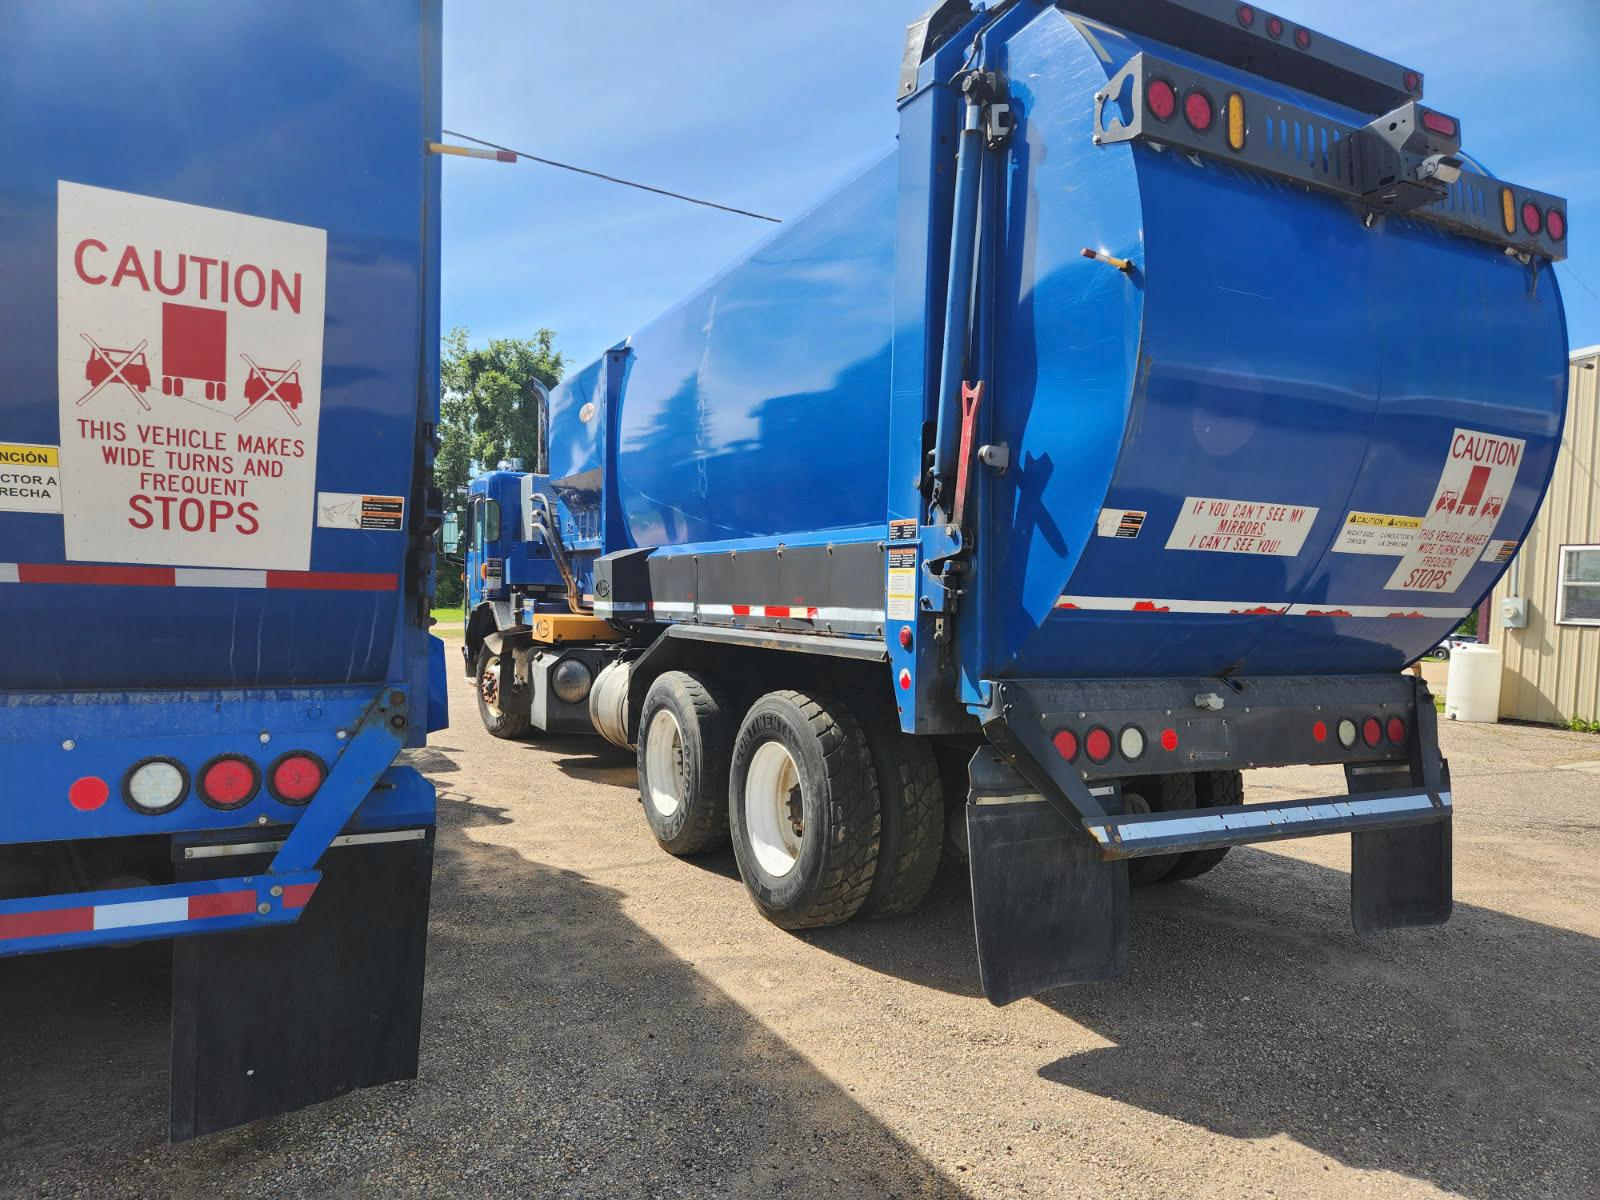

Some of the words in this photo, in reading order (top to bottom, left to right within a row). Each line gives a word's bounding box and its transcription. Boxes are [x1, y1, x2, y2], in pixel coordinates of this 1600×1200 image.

[74, 239, 302, 314] CAUTION
[77, 419, 126, 441] THIS
[137, 425, 226, 451] VEHICLE
[238, 434, 305, 458] MAKES
[1452, 434, 1520, 466] CAUTION
[102, 446, 153, 468] WIDE
[167, 452, 234, 475] TURNS
[243, 458, 283, 478] AND
[0, 474, 43, 485] CTOR
[47, 476, 57, 486] A
[140, 473, 248, 497] FREQUENT
[0, 487, 51, 498] RECHA
[128, 494, 260, 535] STOPS
[1192, 501, 1206, 515] IF
[1208, 502, 1229, 517] YOU
[1233, 503, 1264, 520] CAN'T
[1266, 507, 1287, 522] SEE
[1289, 509, 1306, 523] MY
[1356, 517, 1384, 525] CAUTION
[1189, 535, 1197, 548] I
[1198, 535, 1231, 549] CAN'T
[1233, 537, 1255, 551] SEE
[1257, 539, 1282, 553] YOU!
[1419, 528, 1435, 539] THIS
[1436, 530, 1465, 543] VEHICLE
[1464, 533, 1489, 546] MAKES
[1417, 543, 1438, 554] WIDE
[1437, 544, 1460, 556] TURNS
[1459, 546, 1475, 557] AND
[1420, 556, 1459, 568] FREQUENT
[1403, 568, 1452, 589] STOPS
